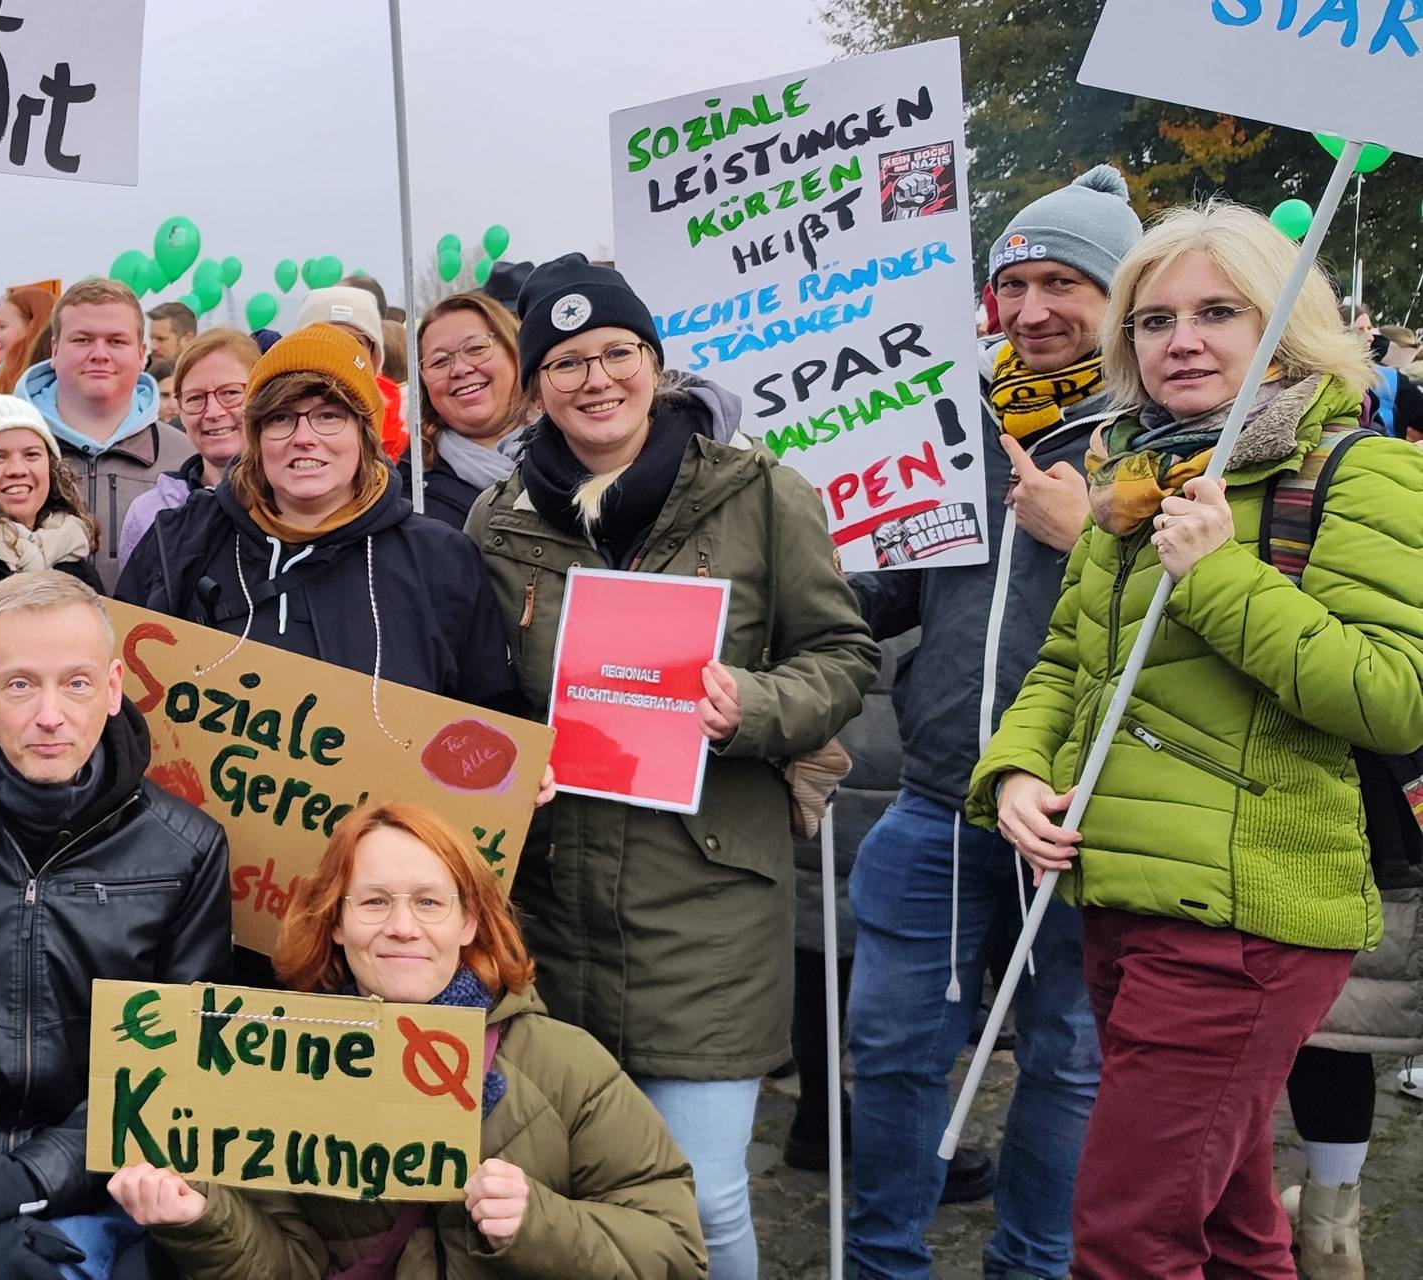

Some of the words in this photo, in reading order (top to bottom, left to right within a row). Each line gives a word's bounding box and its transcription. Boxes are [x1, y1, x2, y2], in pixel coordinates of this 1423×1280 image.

[627, 79, 810, 172] SOZIALE
[648, 86, 933, 212] LEISTUNGEN
[883, 154, 911, 168] KEIN
[914, 146, 950, 161] BOCK
[911, 155, 951, 170] NAZIS
[687, 155, 862, 248] KÜRZEN
[798, 241, 955, 304] RÄNDER
[688, 294, 873, 370] STÄRKEN
[753, 323, 931, 418] SPAR
[815, 441, 946, 520] PEN
[904, 503, 967, 534] STABIL
[907, 518, 976, 552] BLEIBEN
[123, 622, 345, 766] Soziale
[567, 685, 696, 713] FLÜCHTLINGSBERATUNG
[601, 664, 661, 684] REGIONALE
[197, 987, 375, 1081] Keine
[112, 1066, 468, 1203] Kürzungen
